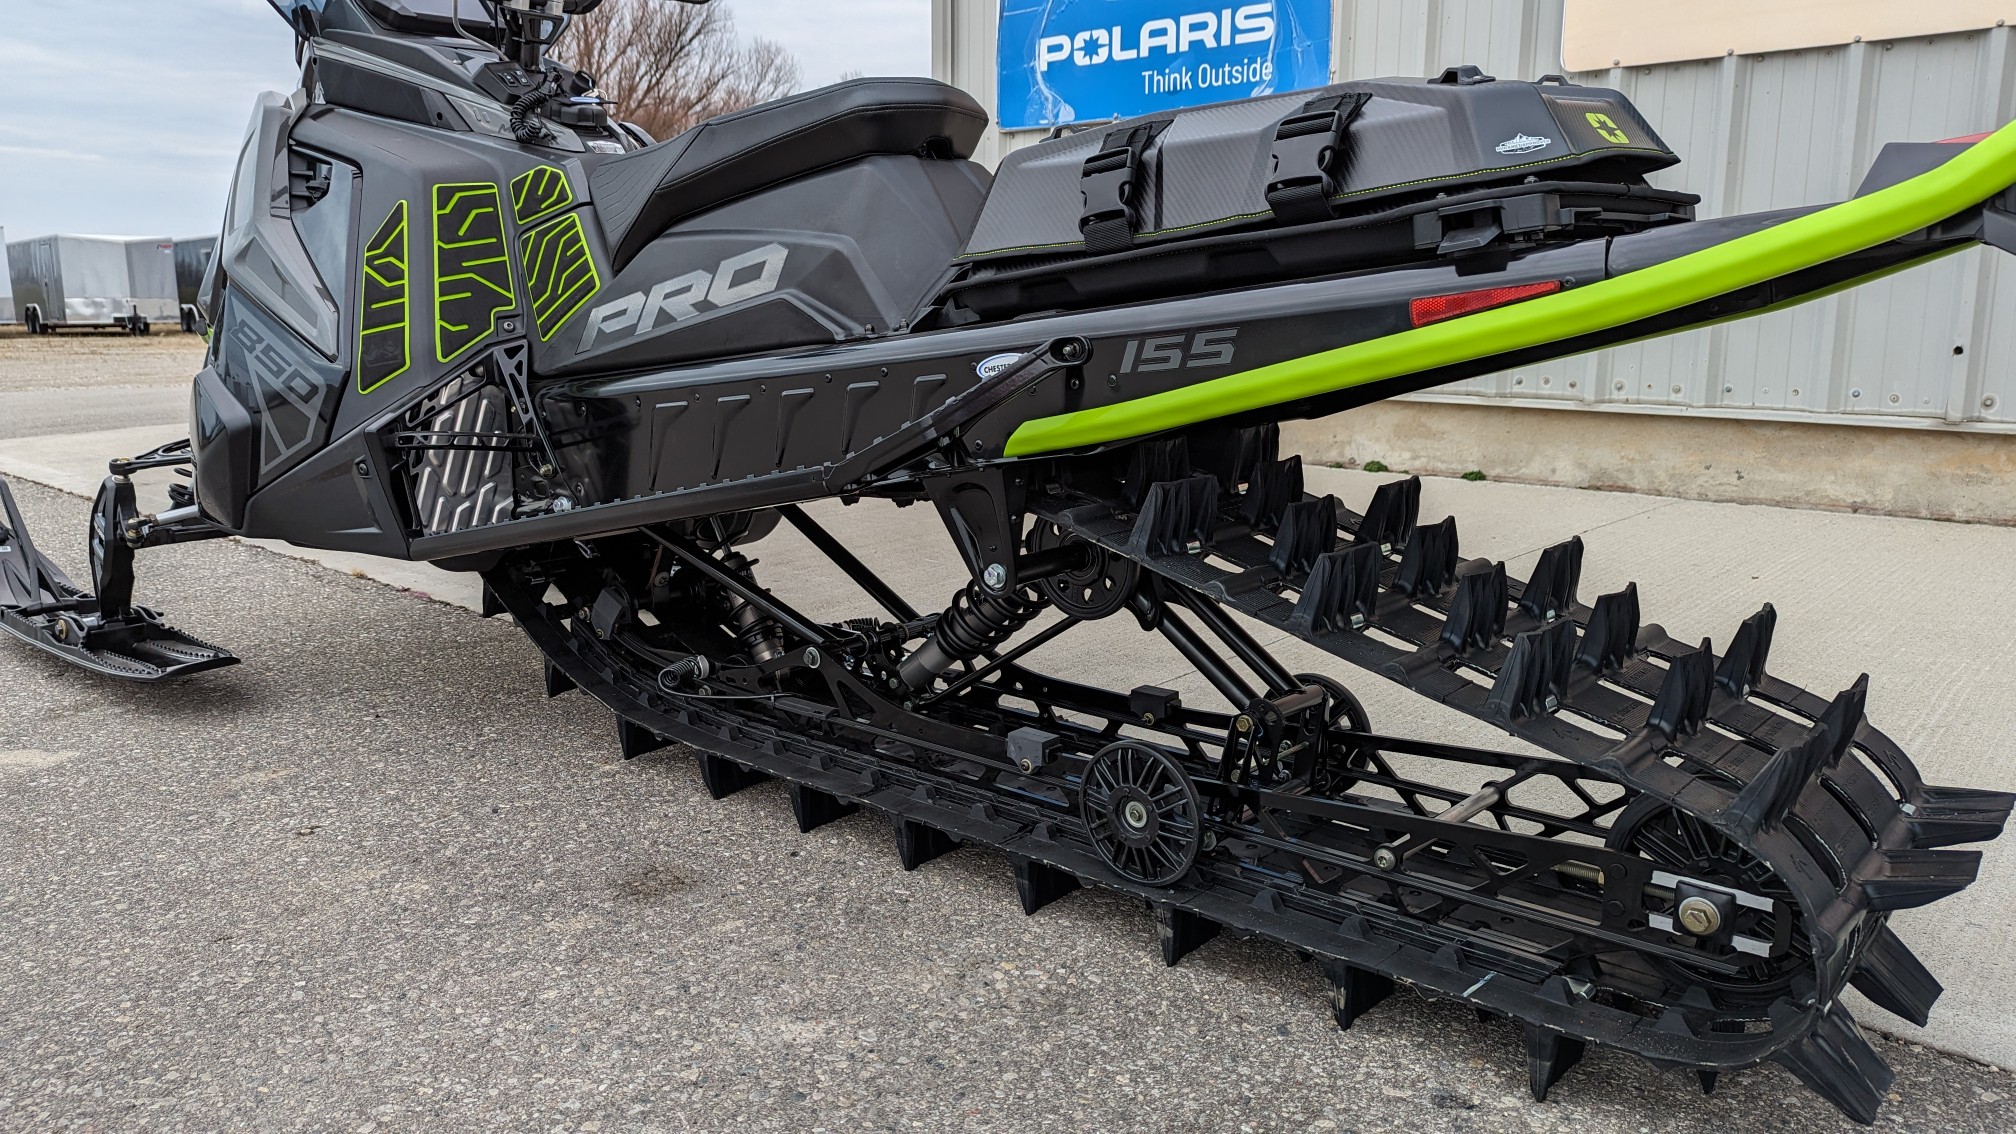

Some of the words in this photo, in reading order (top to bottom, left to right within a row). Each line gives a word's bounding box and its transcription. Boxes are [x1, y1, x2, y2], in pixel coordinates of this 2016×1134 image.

[1039, 2, 1276, 72] POLARIS
[1141, 63, 1193, 96] Think
[1198, 56, 1274, 89] Outside
[574, 242, 790, 355] PRO
[229, 318, 320, 405] 850
[1119, 326, 1240, 374] 155
